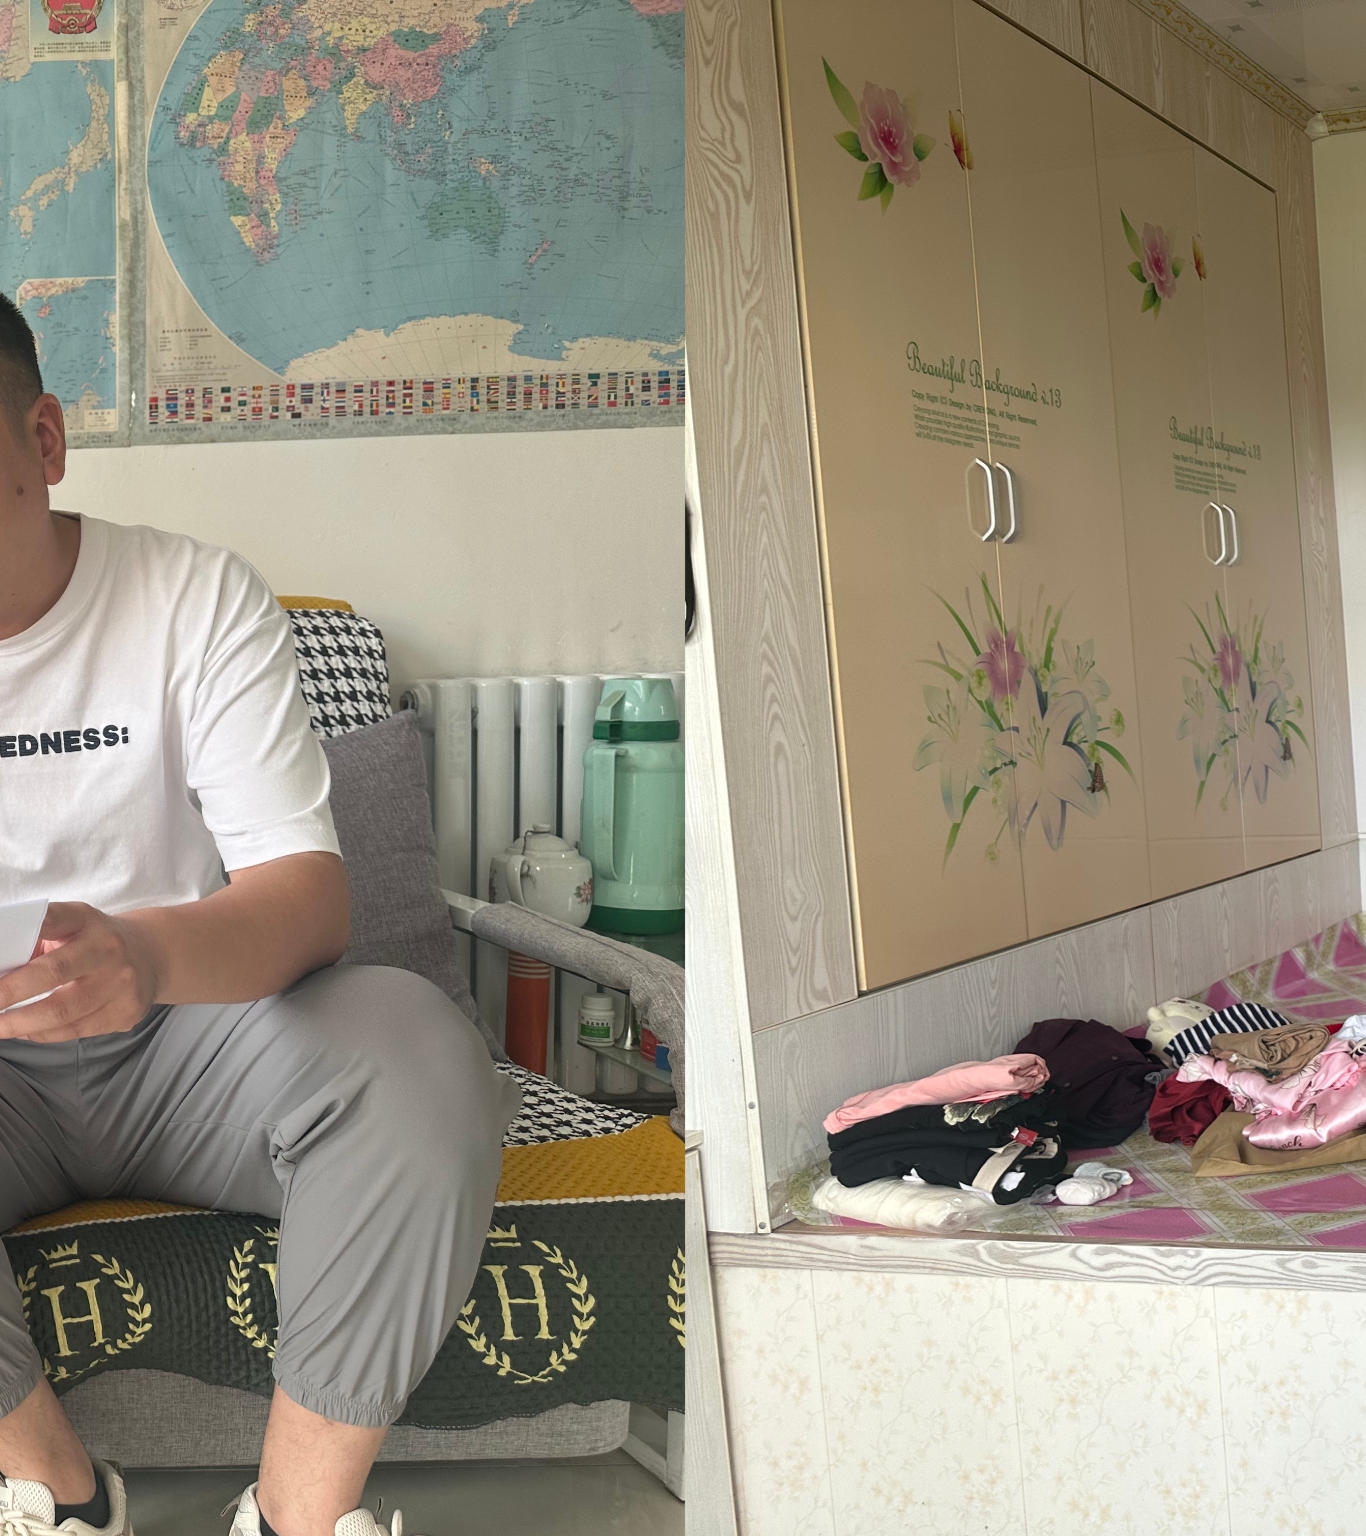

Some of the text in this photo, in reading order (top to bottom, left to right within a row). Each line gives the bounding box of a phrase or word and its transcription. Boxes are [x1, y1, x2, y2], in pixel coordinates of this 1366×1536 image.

[906, 341, 966, 393] Beautiful
[969, 359, 1039, 406] Background
[40, 1278, 112, 1357] H
[482, 1264, 557, 1341] H
